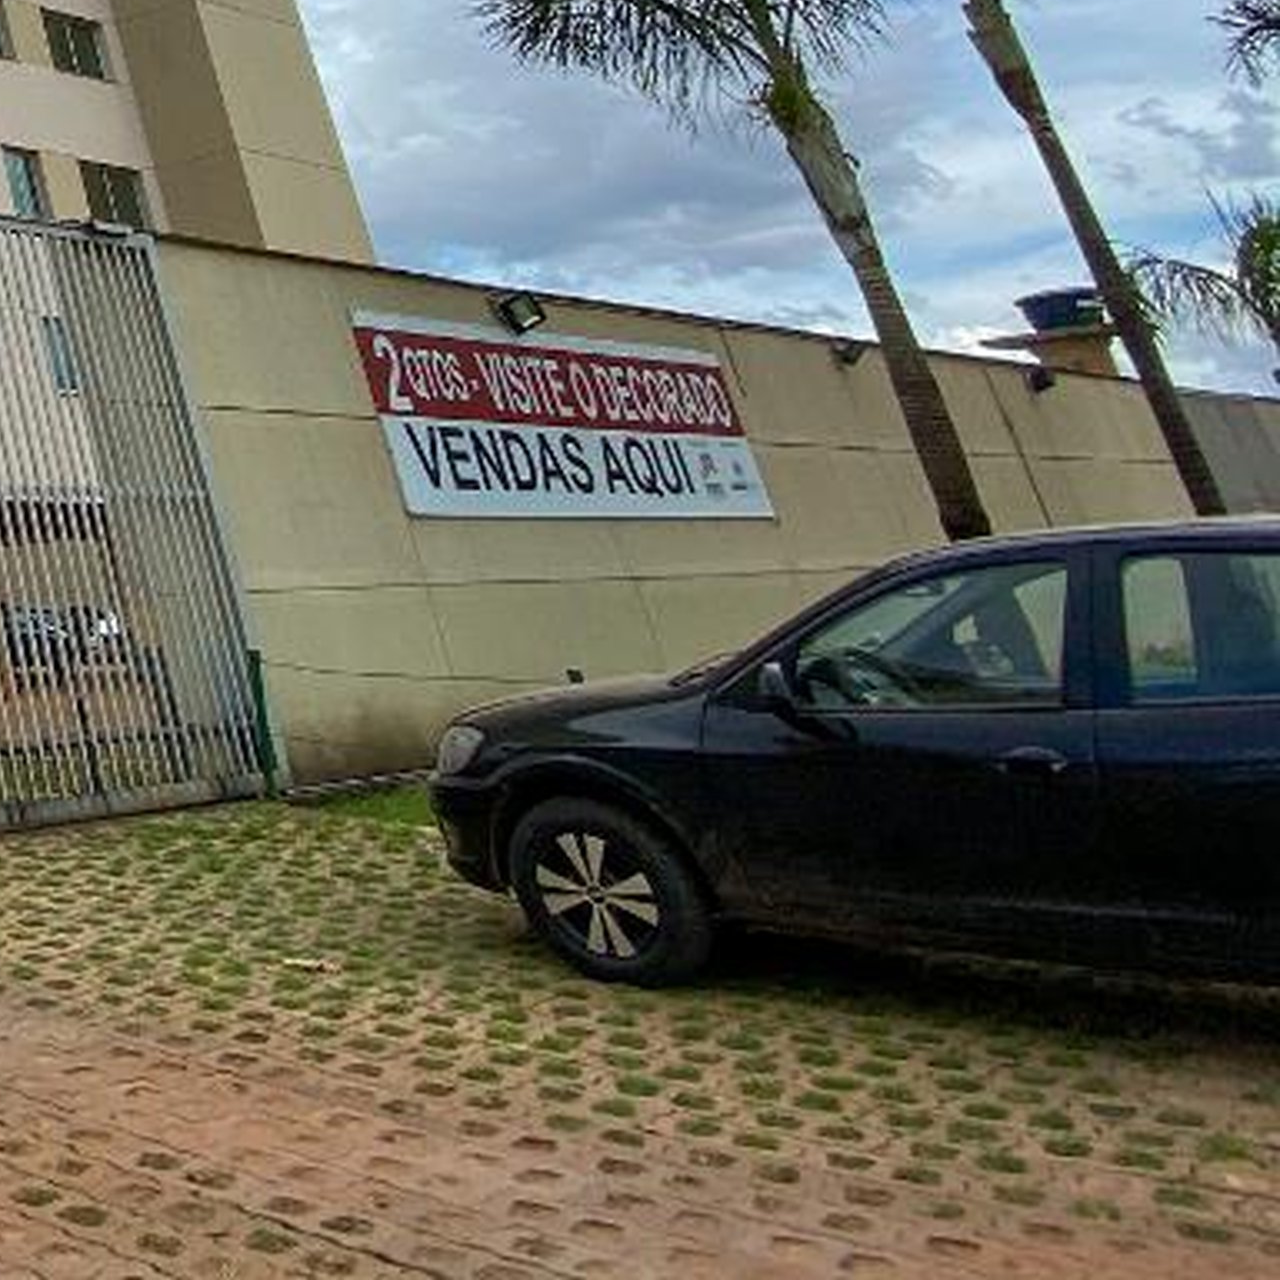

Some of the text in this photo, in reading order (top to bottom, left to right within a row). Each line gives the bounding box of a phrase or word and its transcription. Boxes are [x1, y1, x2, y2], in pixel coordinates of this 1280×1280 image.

[372, 333, 414, 414] 2
[473, 351, 577, 416] VISITE
[569, 361, 599, 419] O
[590, 362, 733, 428] DECORADO
[404, 422, 696, 498] VENDAS AQUI
